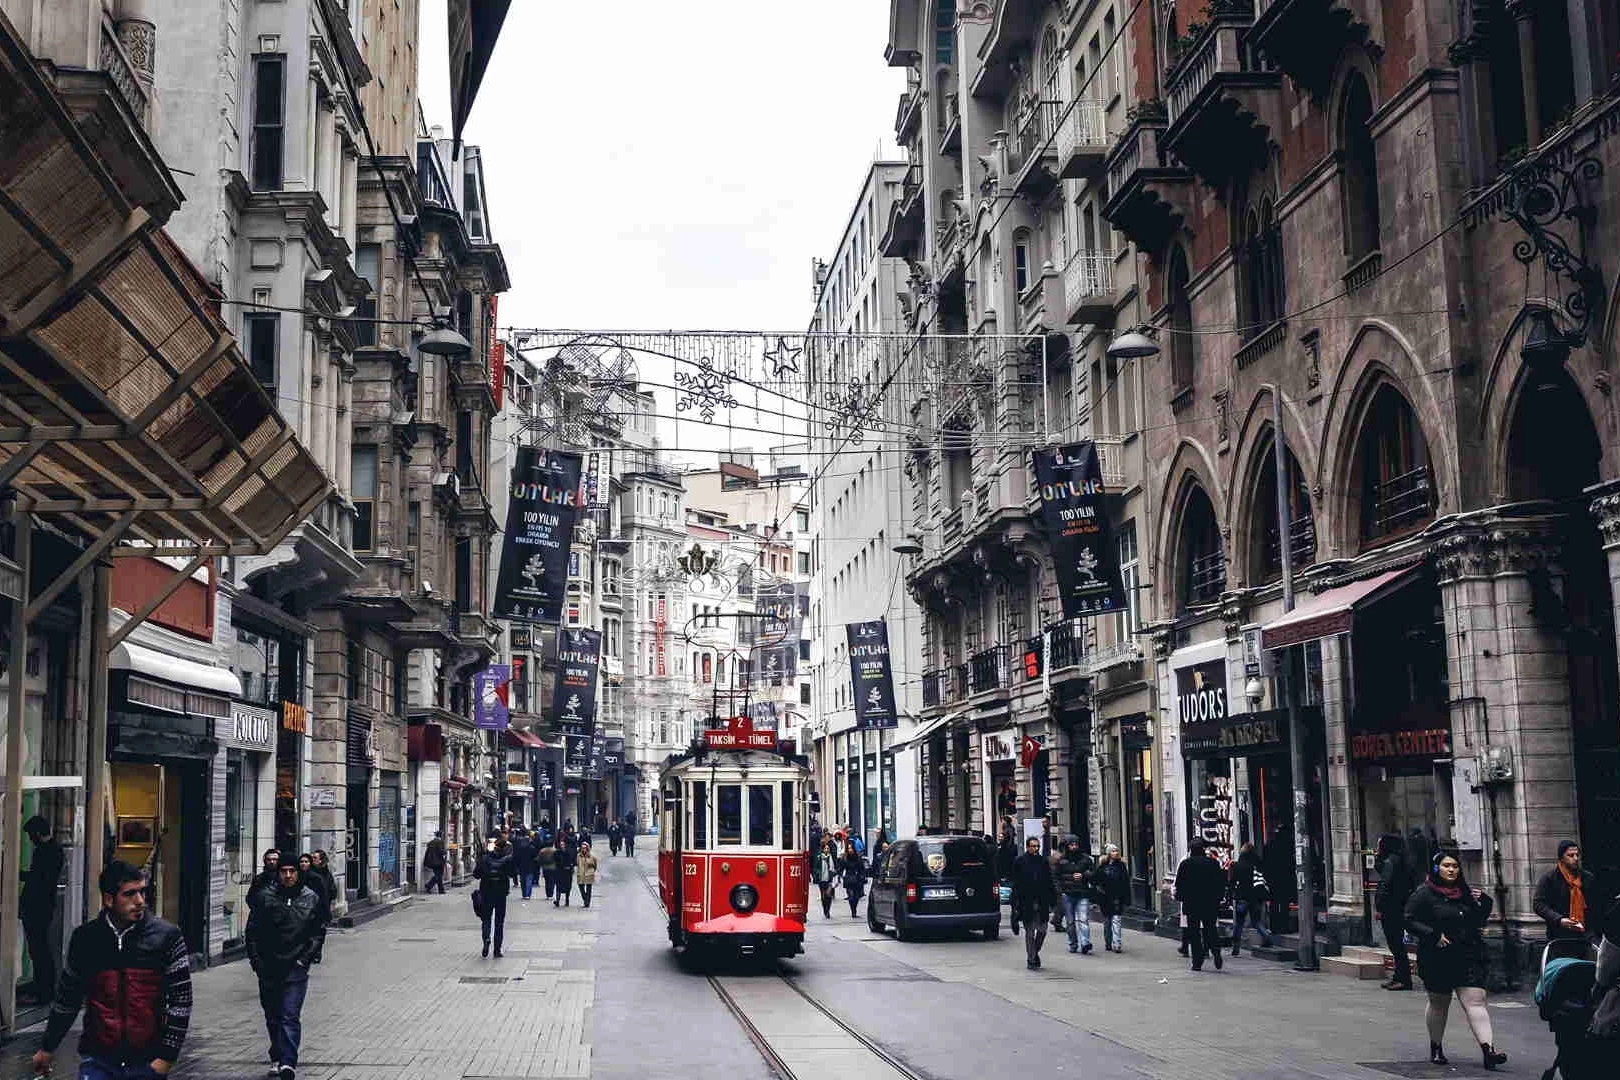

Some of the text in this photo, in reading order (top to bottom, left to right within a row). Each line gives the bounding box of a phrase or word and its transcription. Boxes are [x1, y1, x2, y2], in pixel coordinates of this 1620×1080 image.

[523, 511, 537, 523] 100
[1060, 509, 1074, 520] 100
[737, 717, 744, 728] 2
[748, 733, 773, 745] TÜNEL
